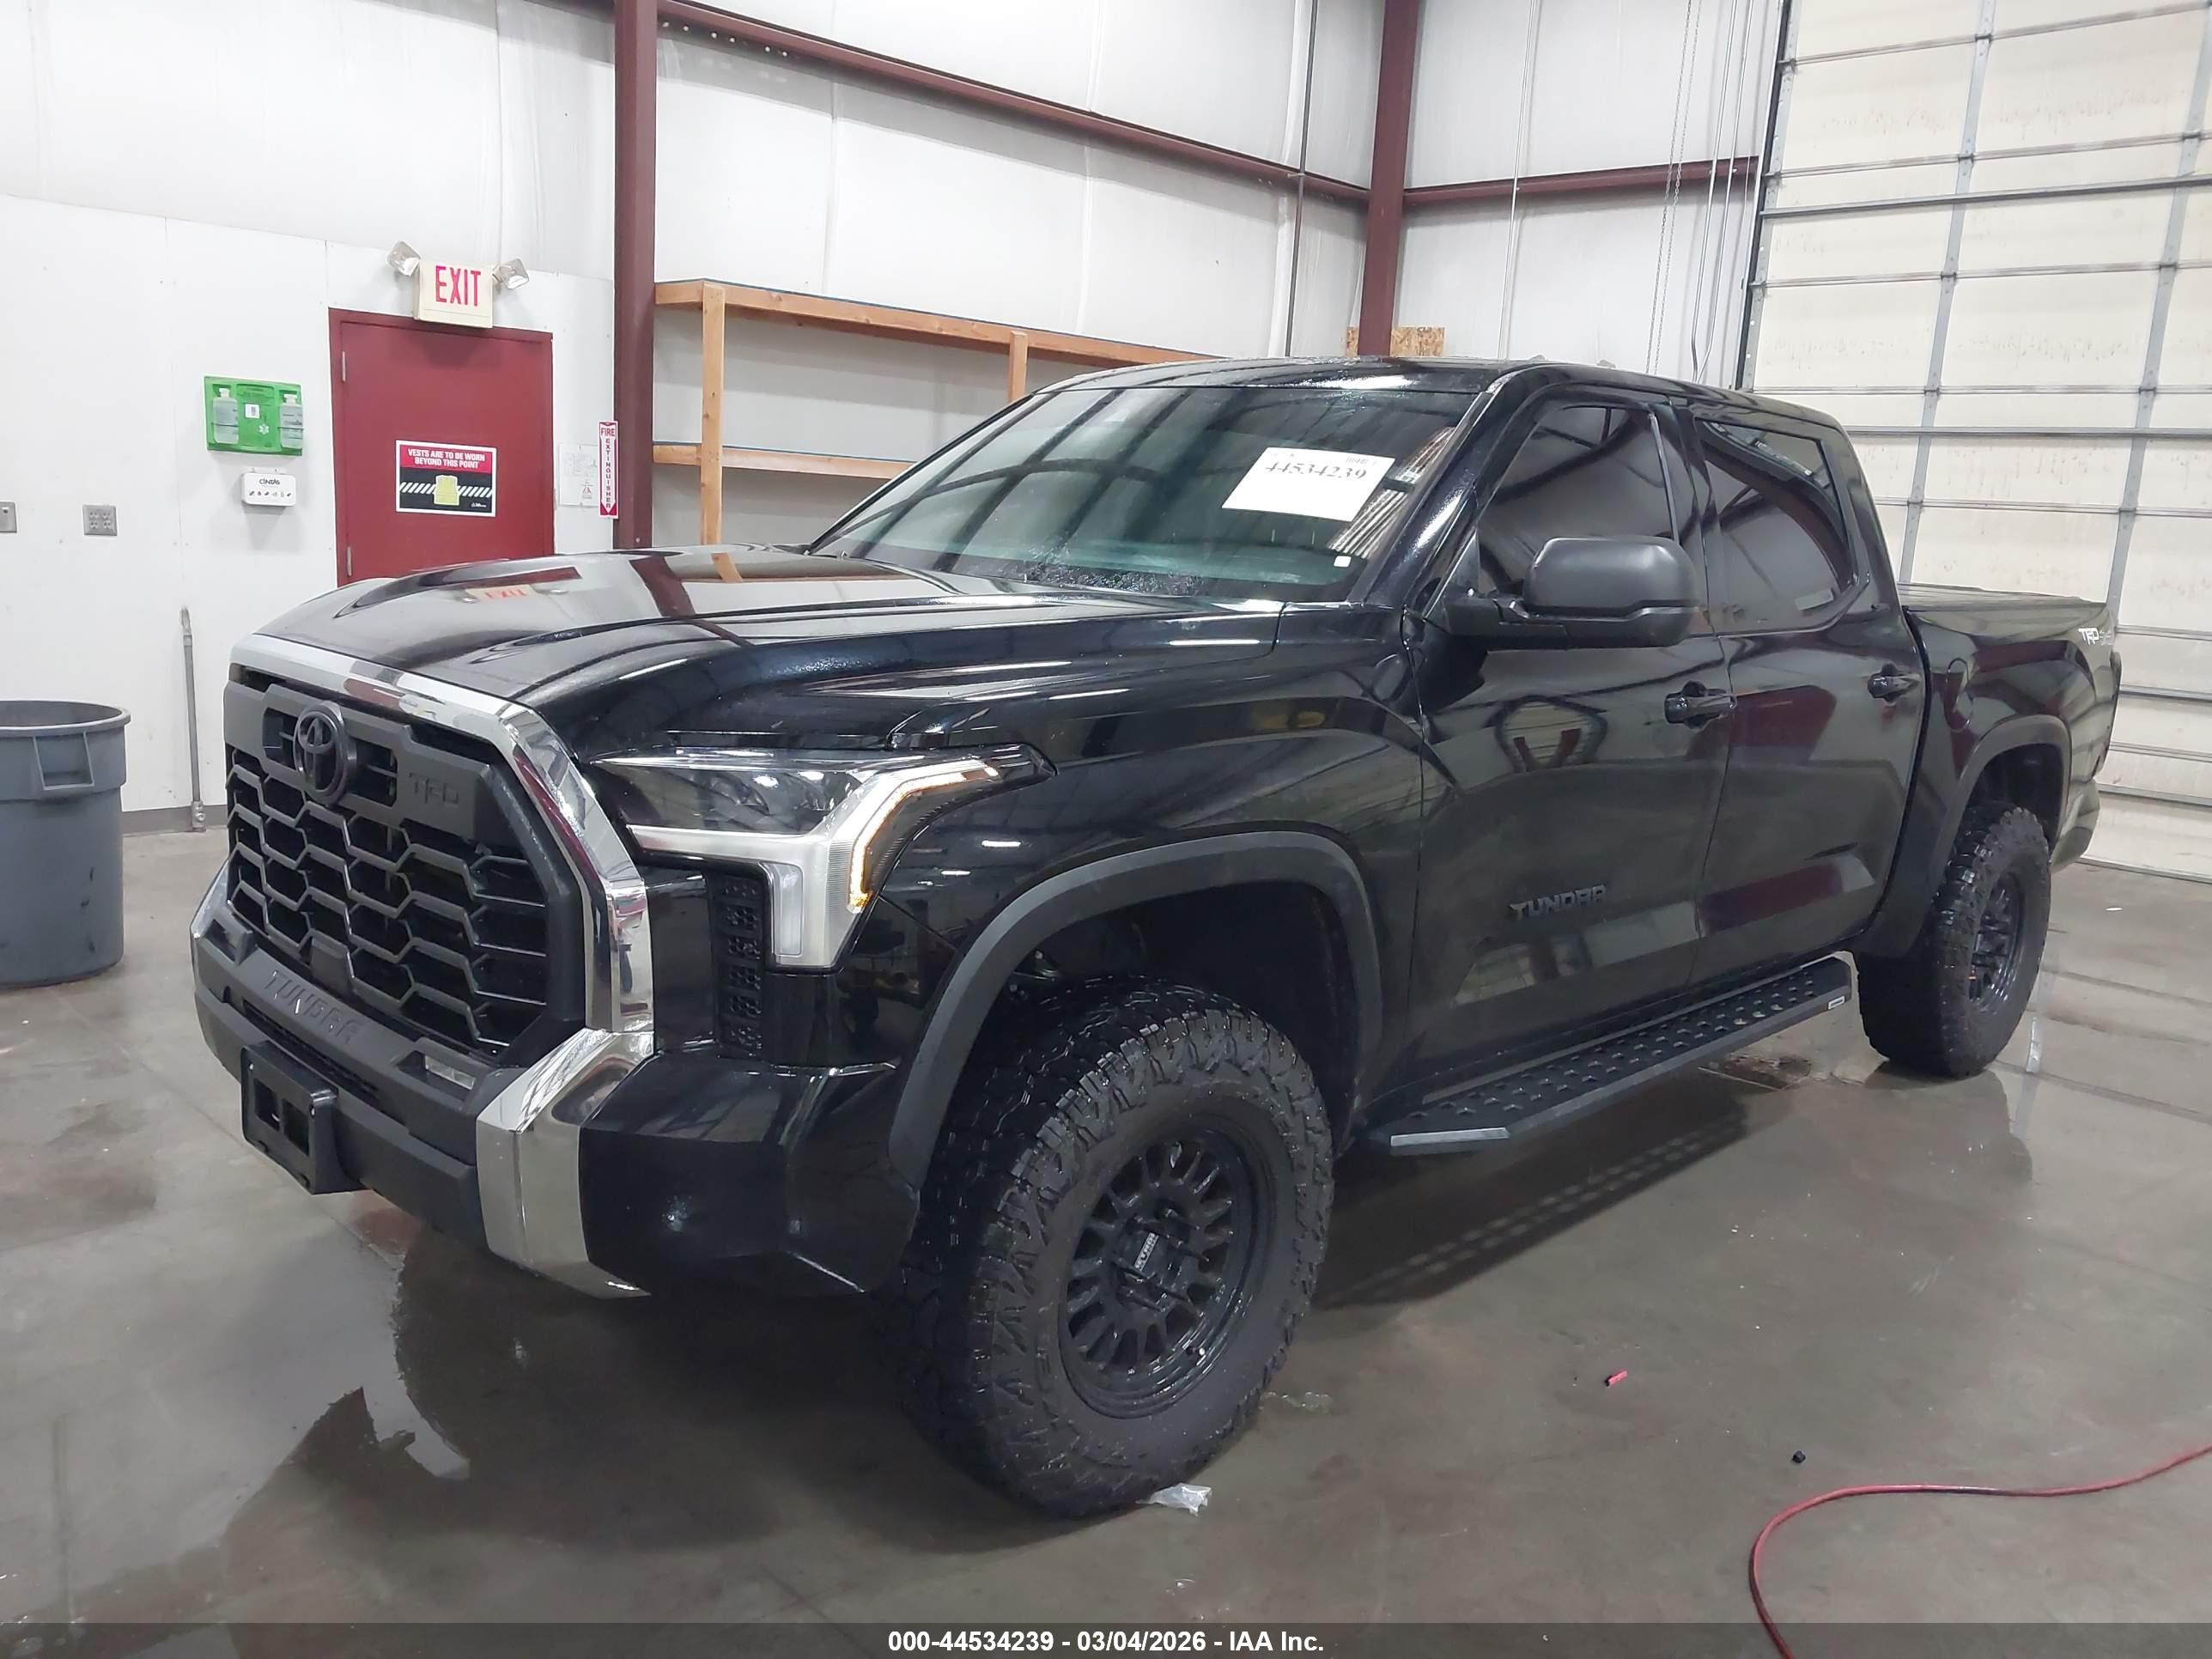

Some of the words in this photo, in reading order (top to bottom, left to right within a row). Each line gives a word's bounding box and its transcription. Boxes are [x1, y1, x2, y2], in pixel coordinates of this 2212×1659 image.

[435, 265, 481, 307] EXIT
[601, 428, 616, 437] FIRE
[408, 448, 429, 457] VESTS
[465, 453, 485, 462] WORN
[415, 457, 442, 466] BEYOND
[443, 459, 458, 467] THIS
[459, 460, 478, 469] POINT
[1265, 461, 1367, 479] 44534239
[2078, 628, 2100, 646] TRD
[1509, 884, 1607, 920] TUNDRA
